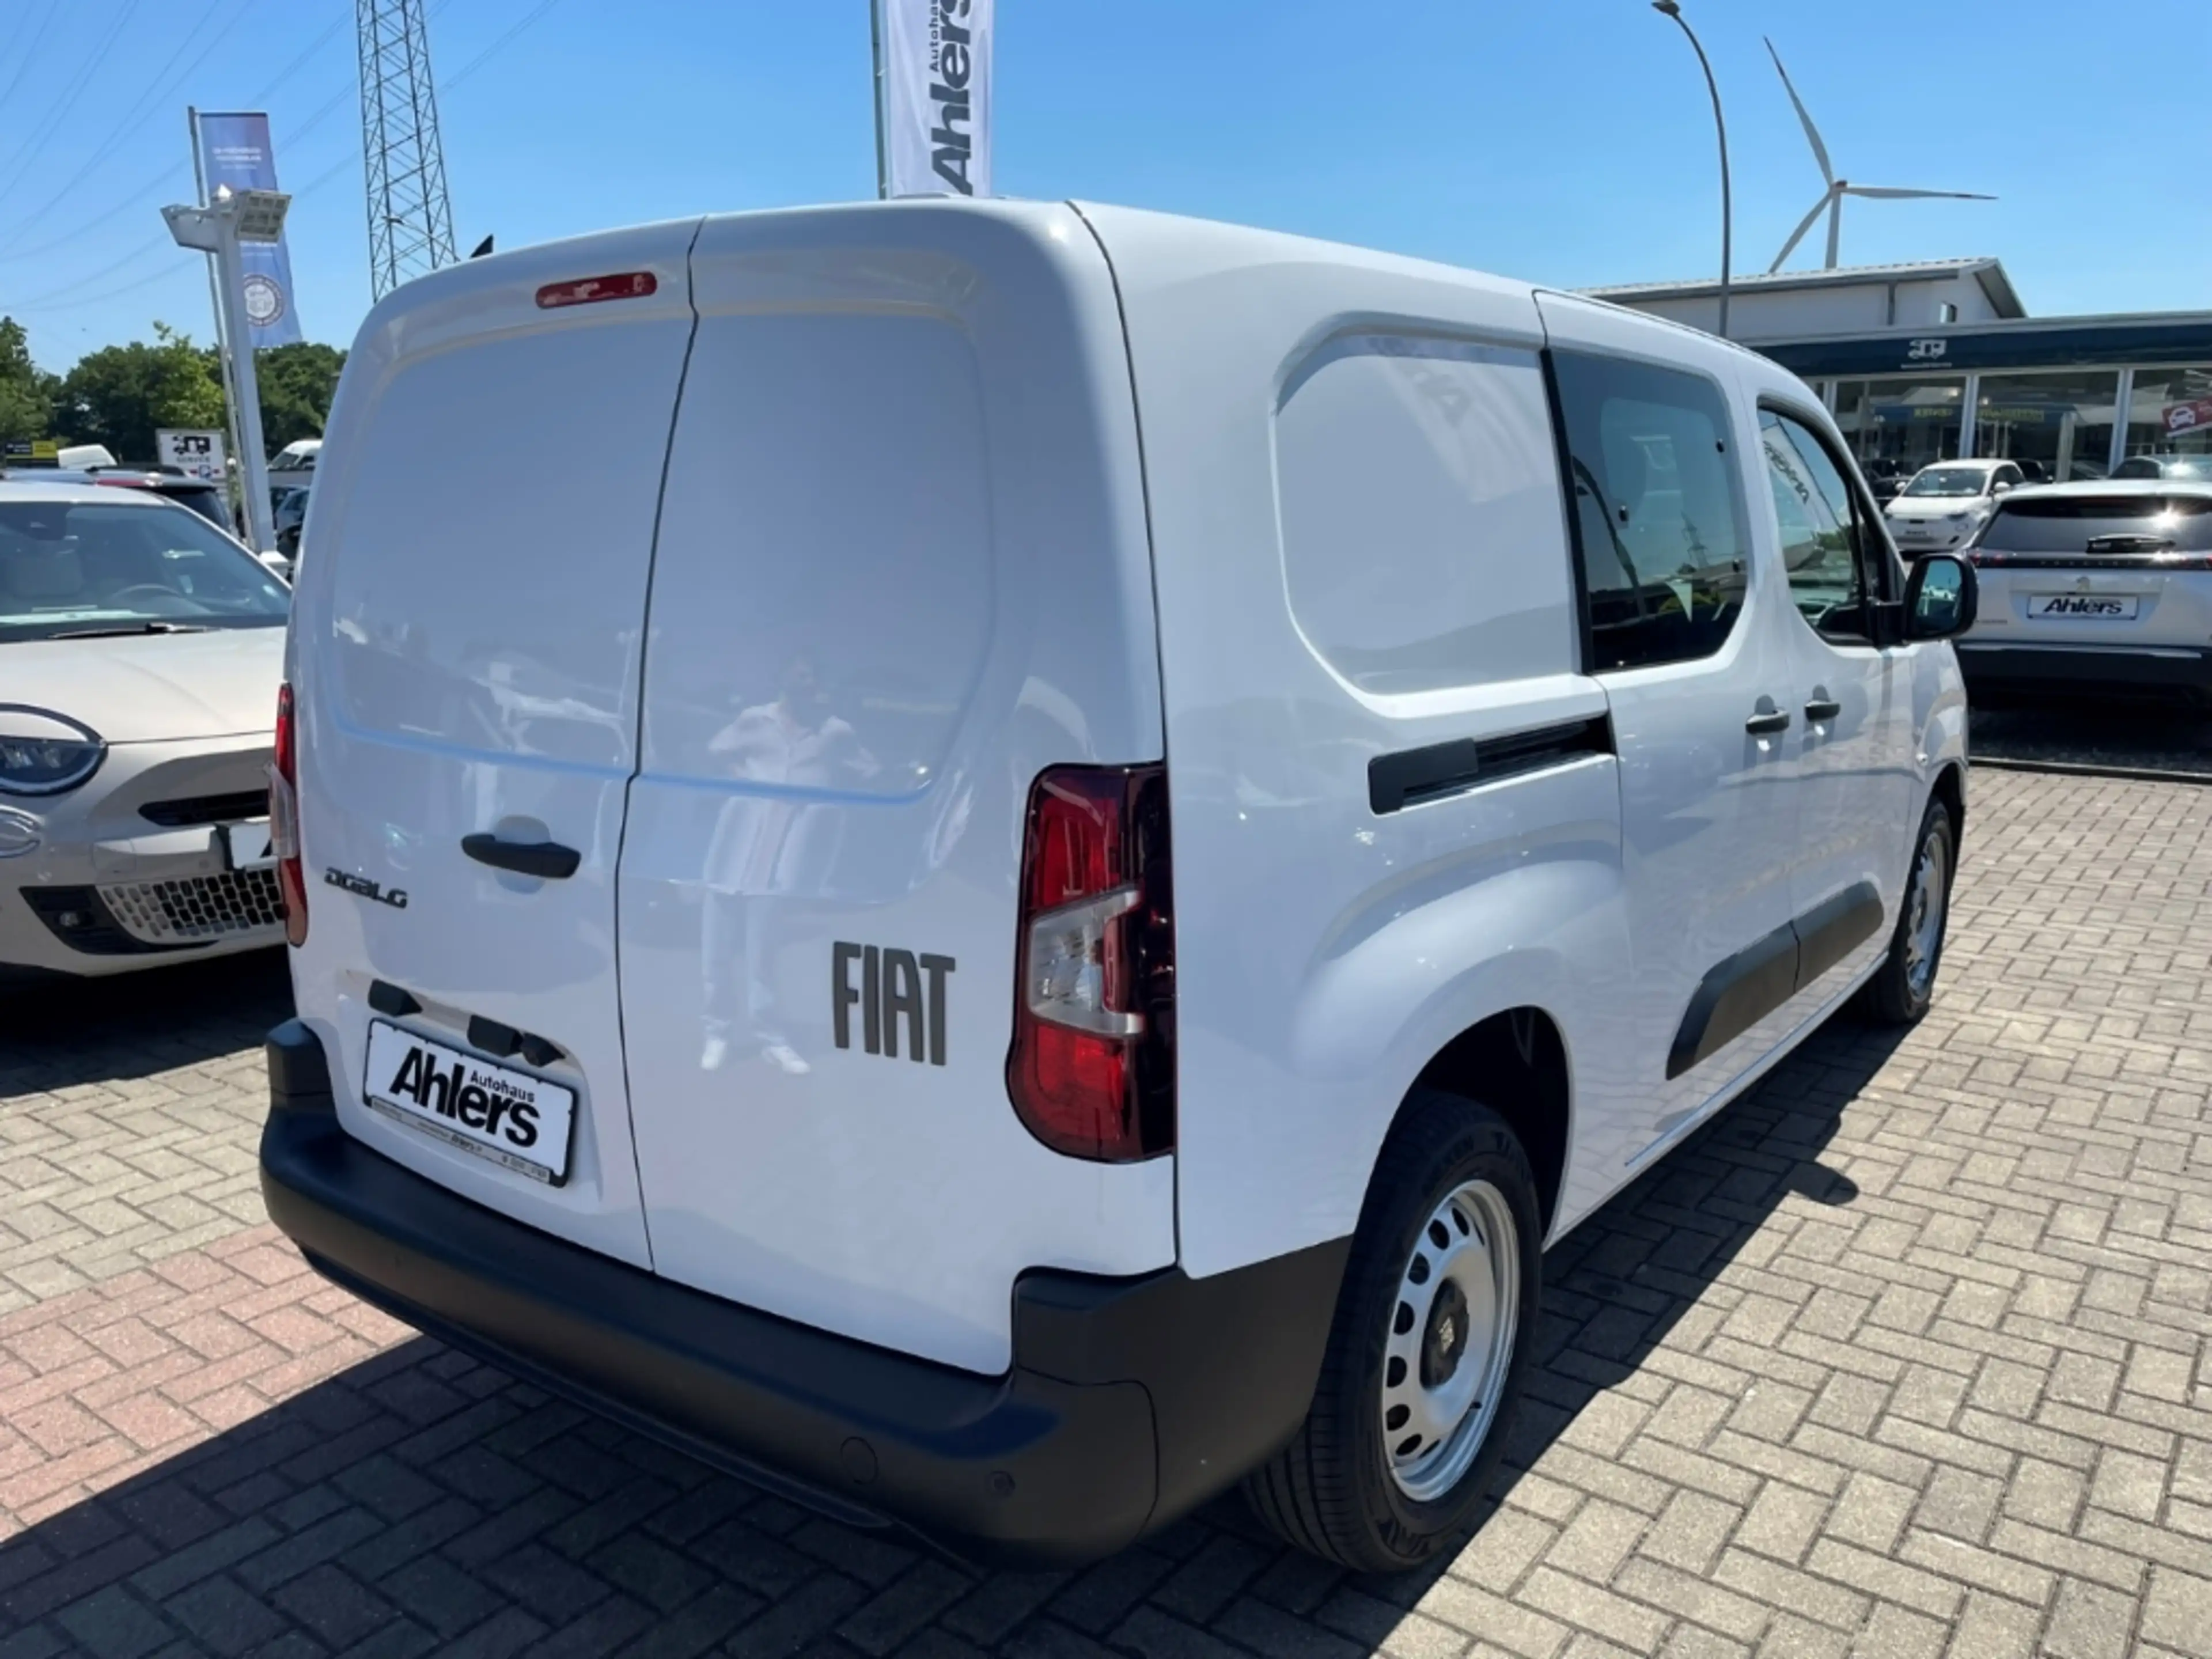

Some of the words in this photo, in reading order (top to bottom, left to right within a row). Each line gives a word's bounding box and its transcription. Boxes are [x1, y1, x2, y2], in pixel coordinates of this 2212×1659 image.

[2043, 597, 2123, 615] Ahlers
[833, 941, 956, 1067] FIAT
[389, 1046, 541, 1148] Ahlers
[469, 1070, 535, 1103] Autohaus
